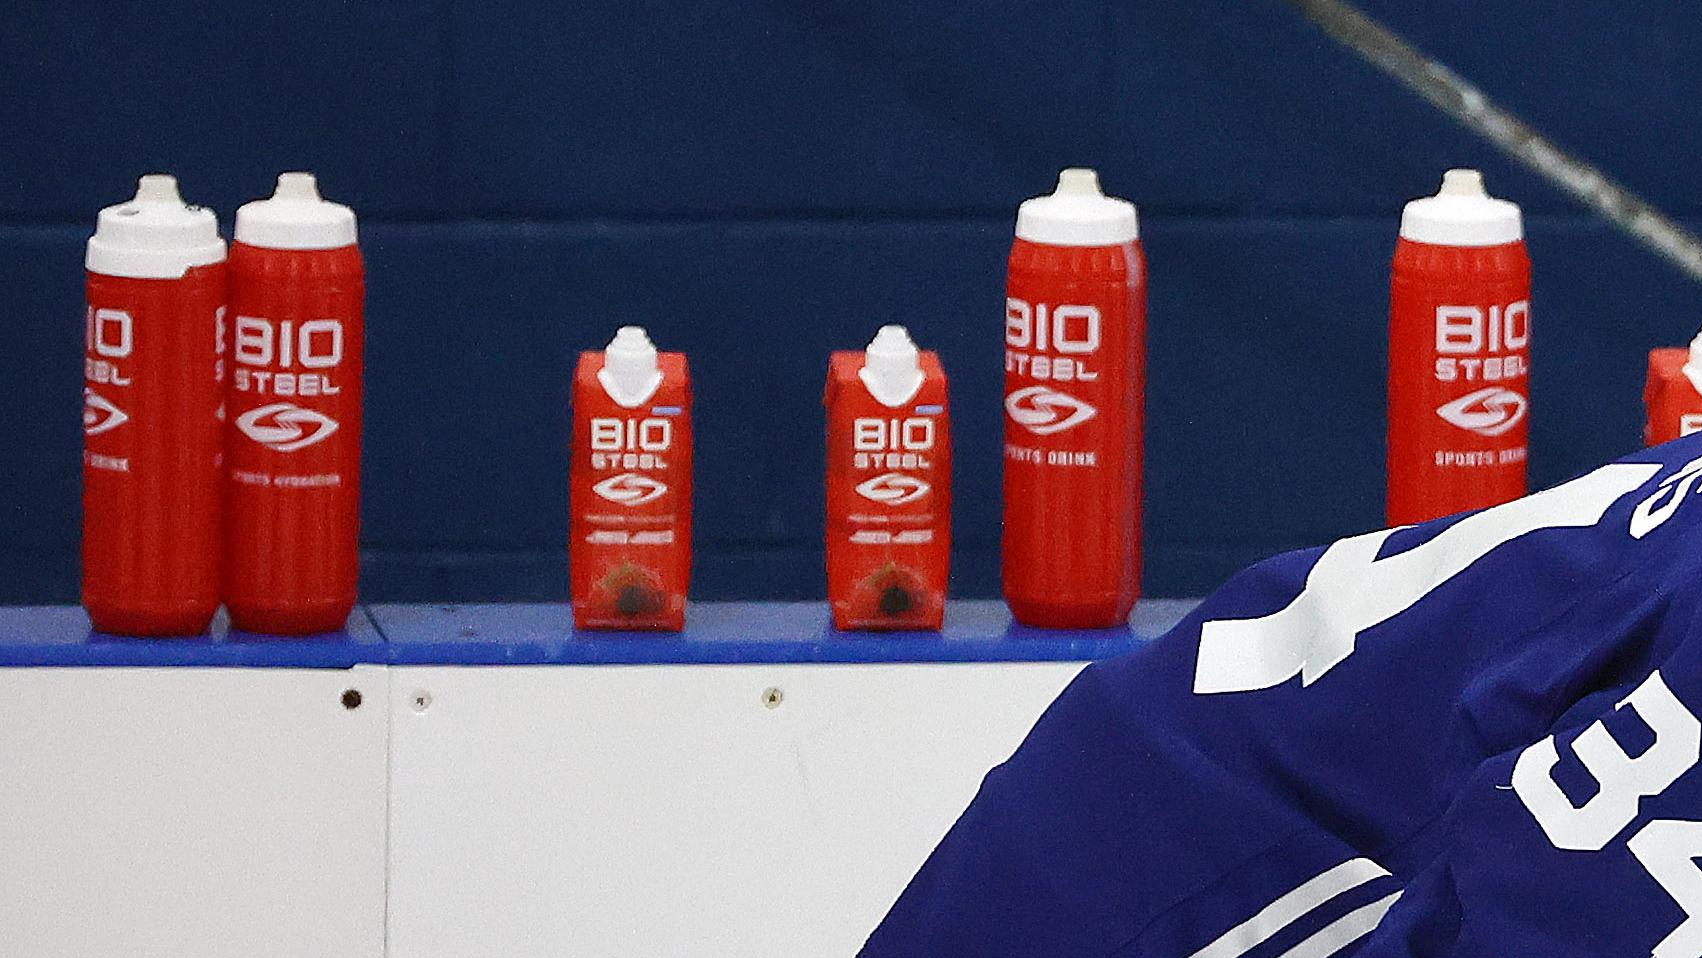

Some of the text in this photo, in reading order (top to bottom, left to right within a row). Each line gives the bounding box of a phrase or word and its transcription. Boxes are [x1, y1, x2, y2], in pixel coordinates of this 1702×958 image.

[86, 304, 132, 357] IO
[235, 315, 343, 368] BIO
[1006, 297, 1100, 353] BIO
[1435, 300, 1529, 353] BIO
[234, 368, 340, 396] STEEL
[1435, 356, 1528, 381] STEEL
[591, 417, 672, 451] BIO
[854, 417, 935, 450] BIO
